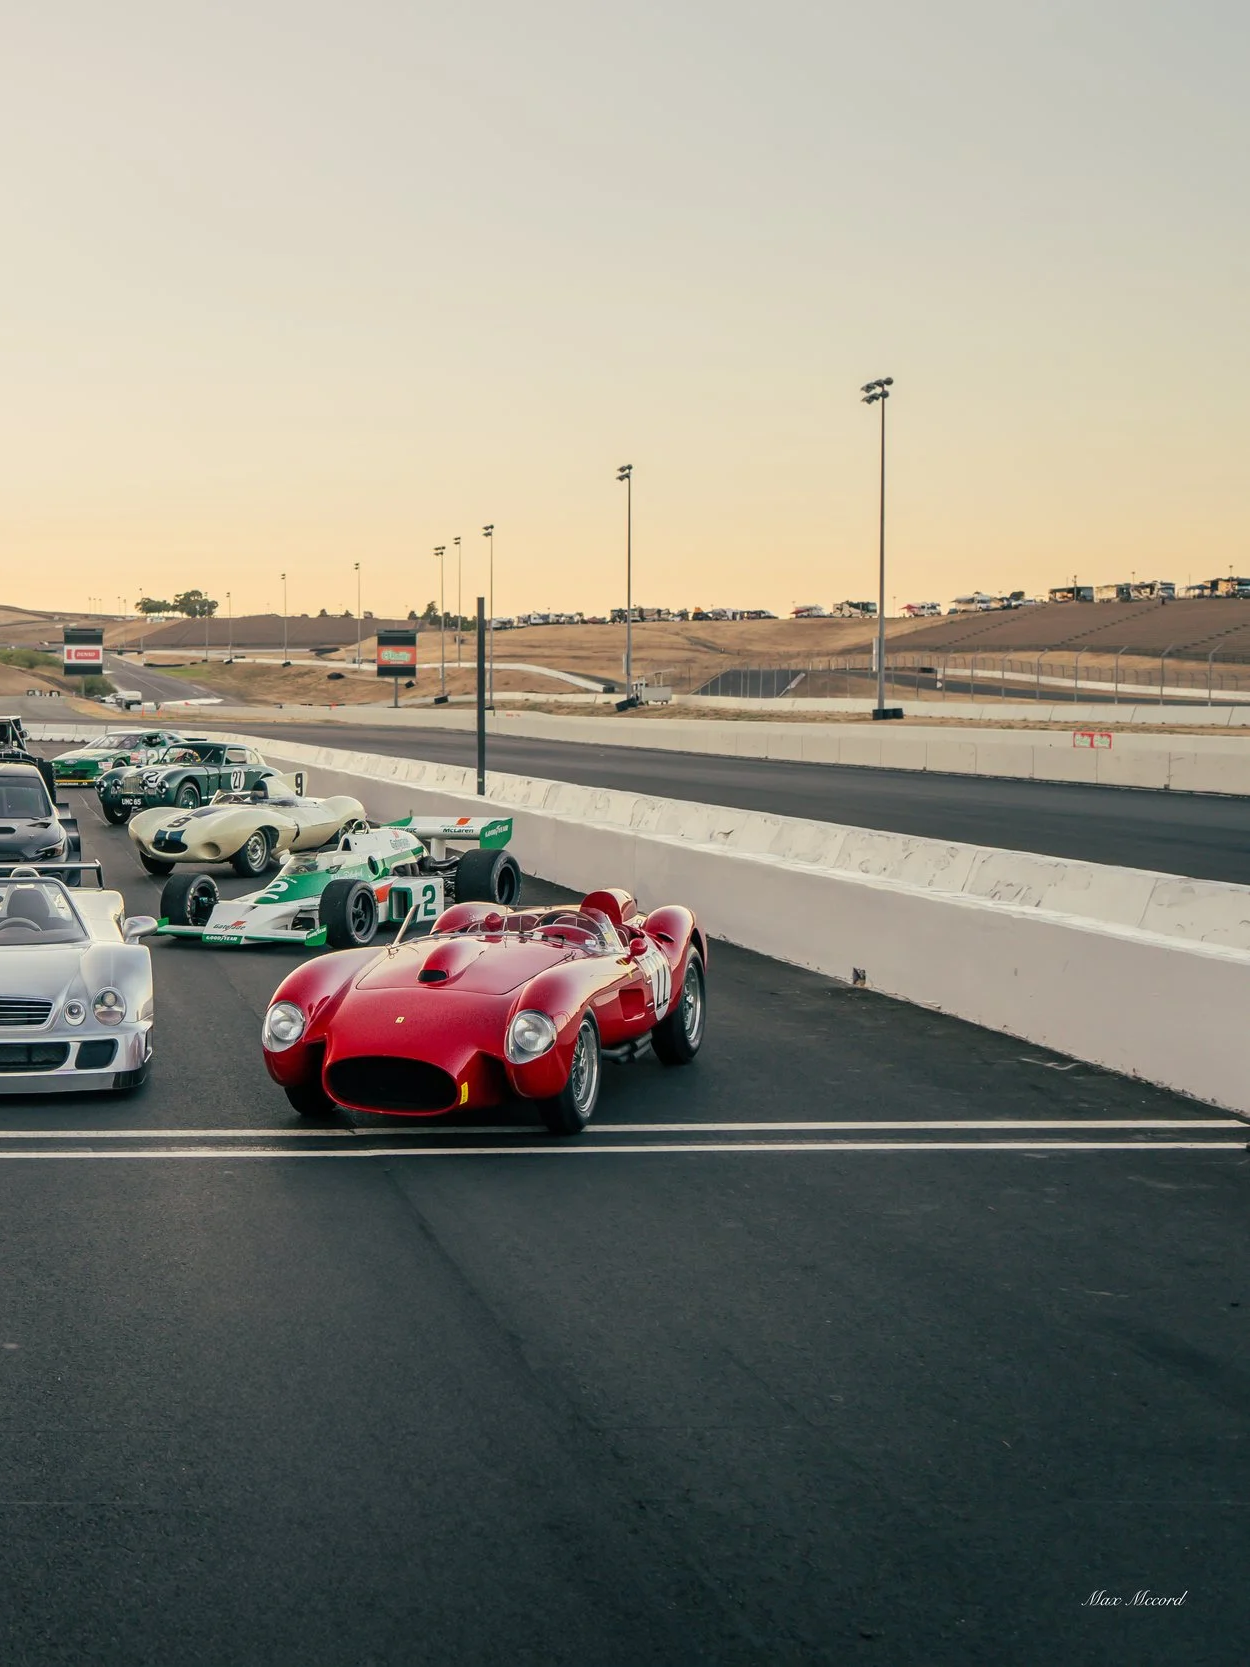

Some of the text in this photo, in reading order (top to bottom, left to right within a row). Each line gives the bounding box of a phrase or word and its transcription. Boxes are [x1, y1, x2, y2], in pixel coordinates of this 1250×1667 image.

[232, 771, 242, 789] 27
[295, 772, 303, 797] 9
[121, 798, 142, 806] UMC 65
[166, 816, 192, 828] 9
[261, 880, 289, 900] 2
[422, 884, 437, 917] 2
[205, 934, 239, 943] GOODYEAR
